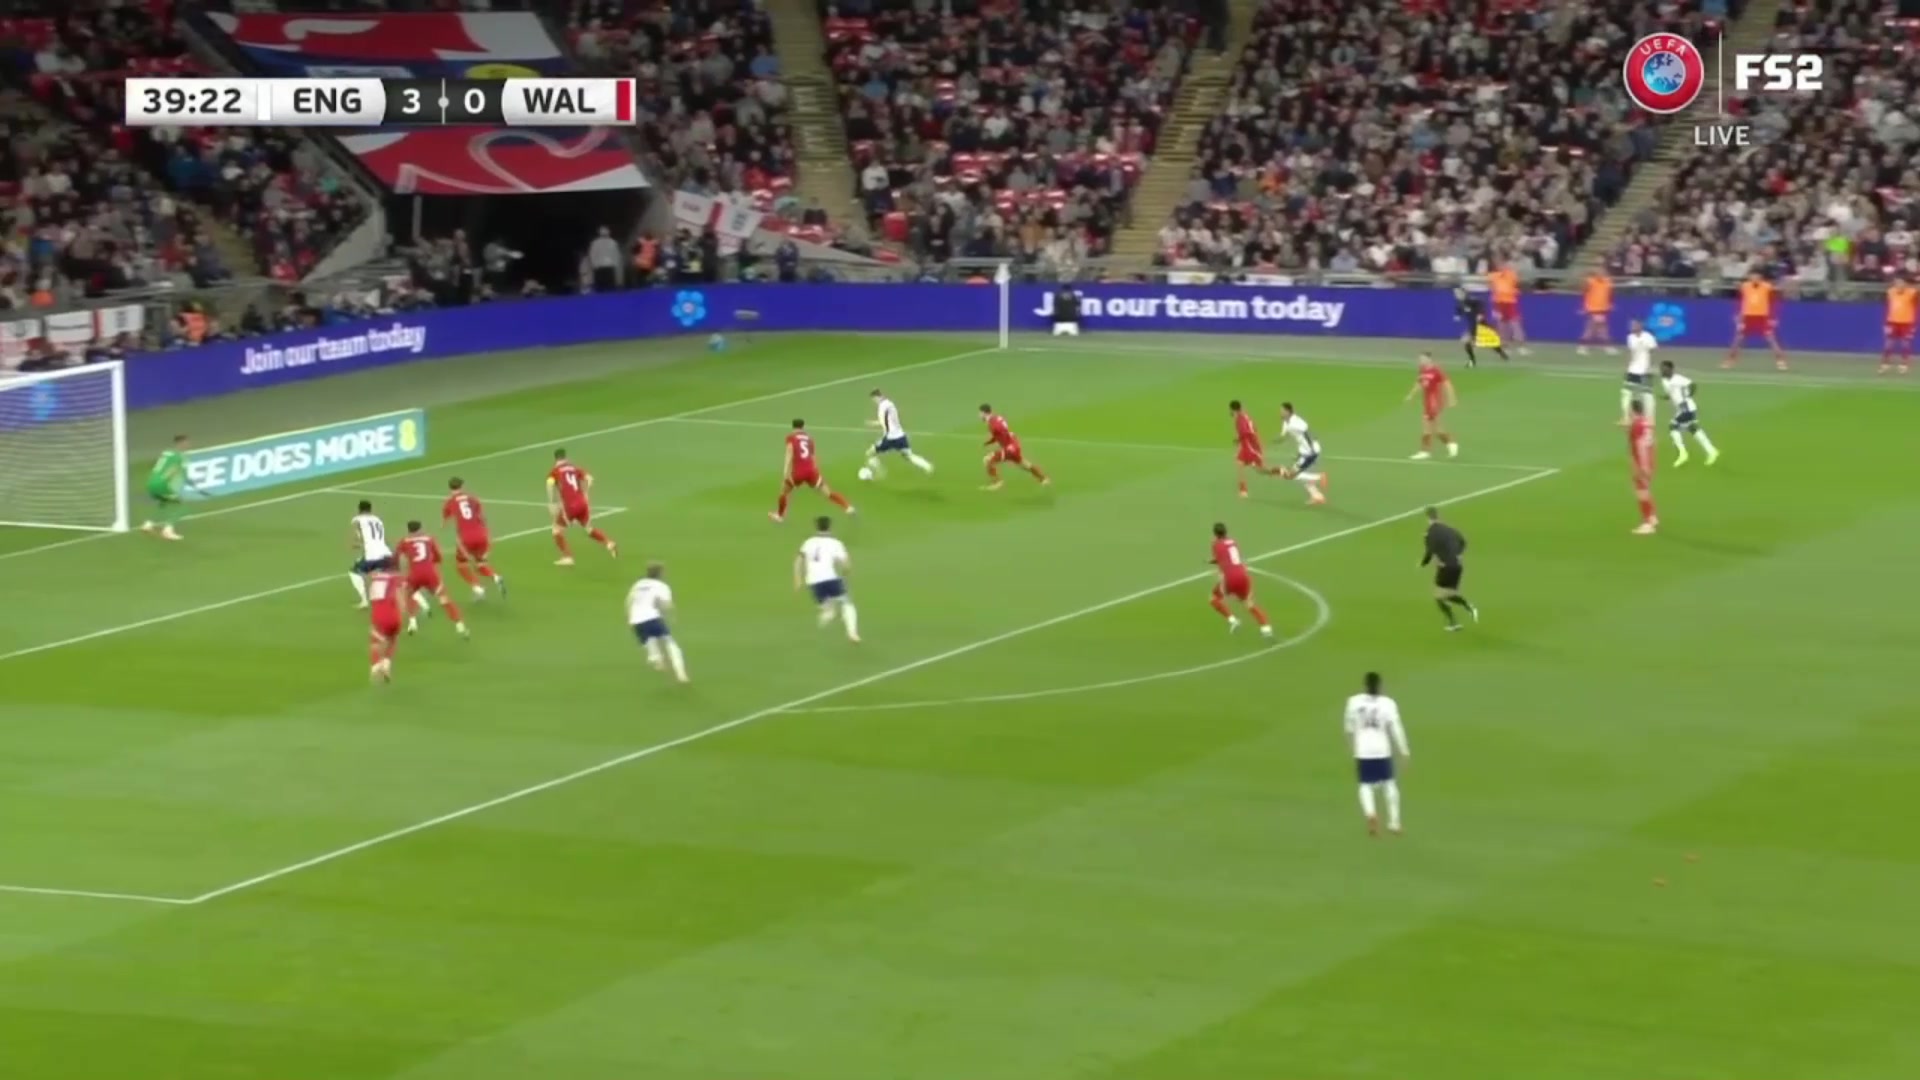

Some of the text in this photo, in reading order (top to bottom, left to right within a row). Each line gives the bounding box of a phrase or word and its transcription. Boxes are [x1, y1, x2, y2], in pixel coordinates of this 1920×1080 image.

[1032, 290, 1345, 328] Jn our team today
[240, 322, 427, 374] Join our team today
[231, 441, 312, 482] DOES
[314, 424, 396, 466] MORE
[798, 441, 810, 459] 5
[565, 472, 579, 492] 4
[458, 499, 473, 520] 6
[411, 540, 427, 562] 3
